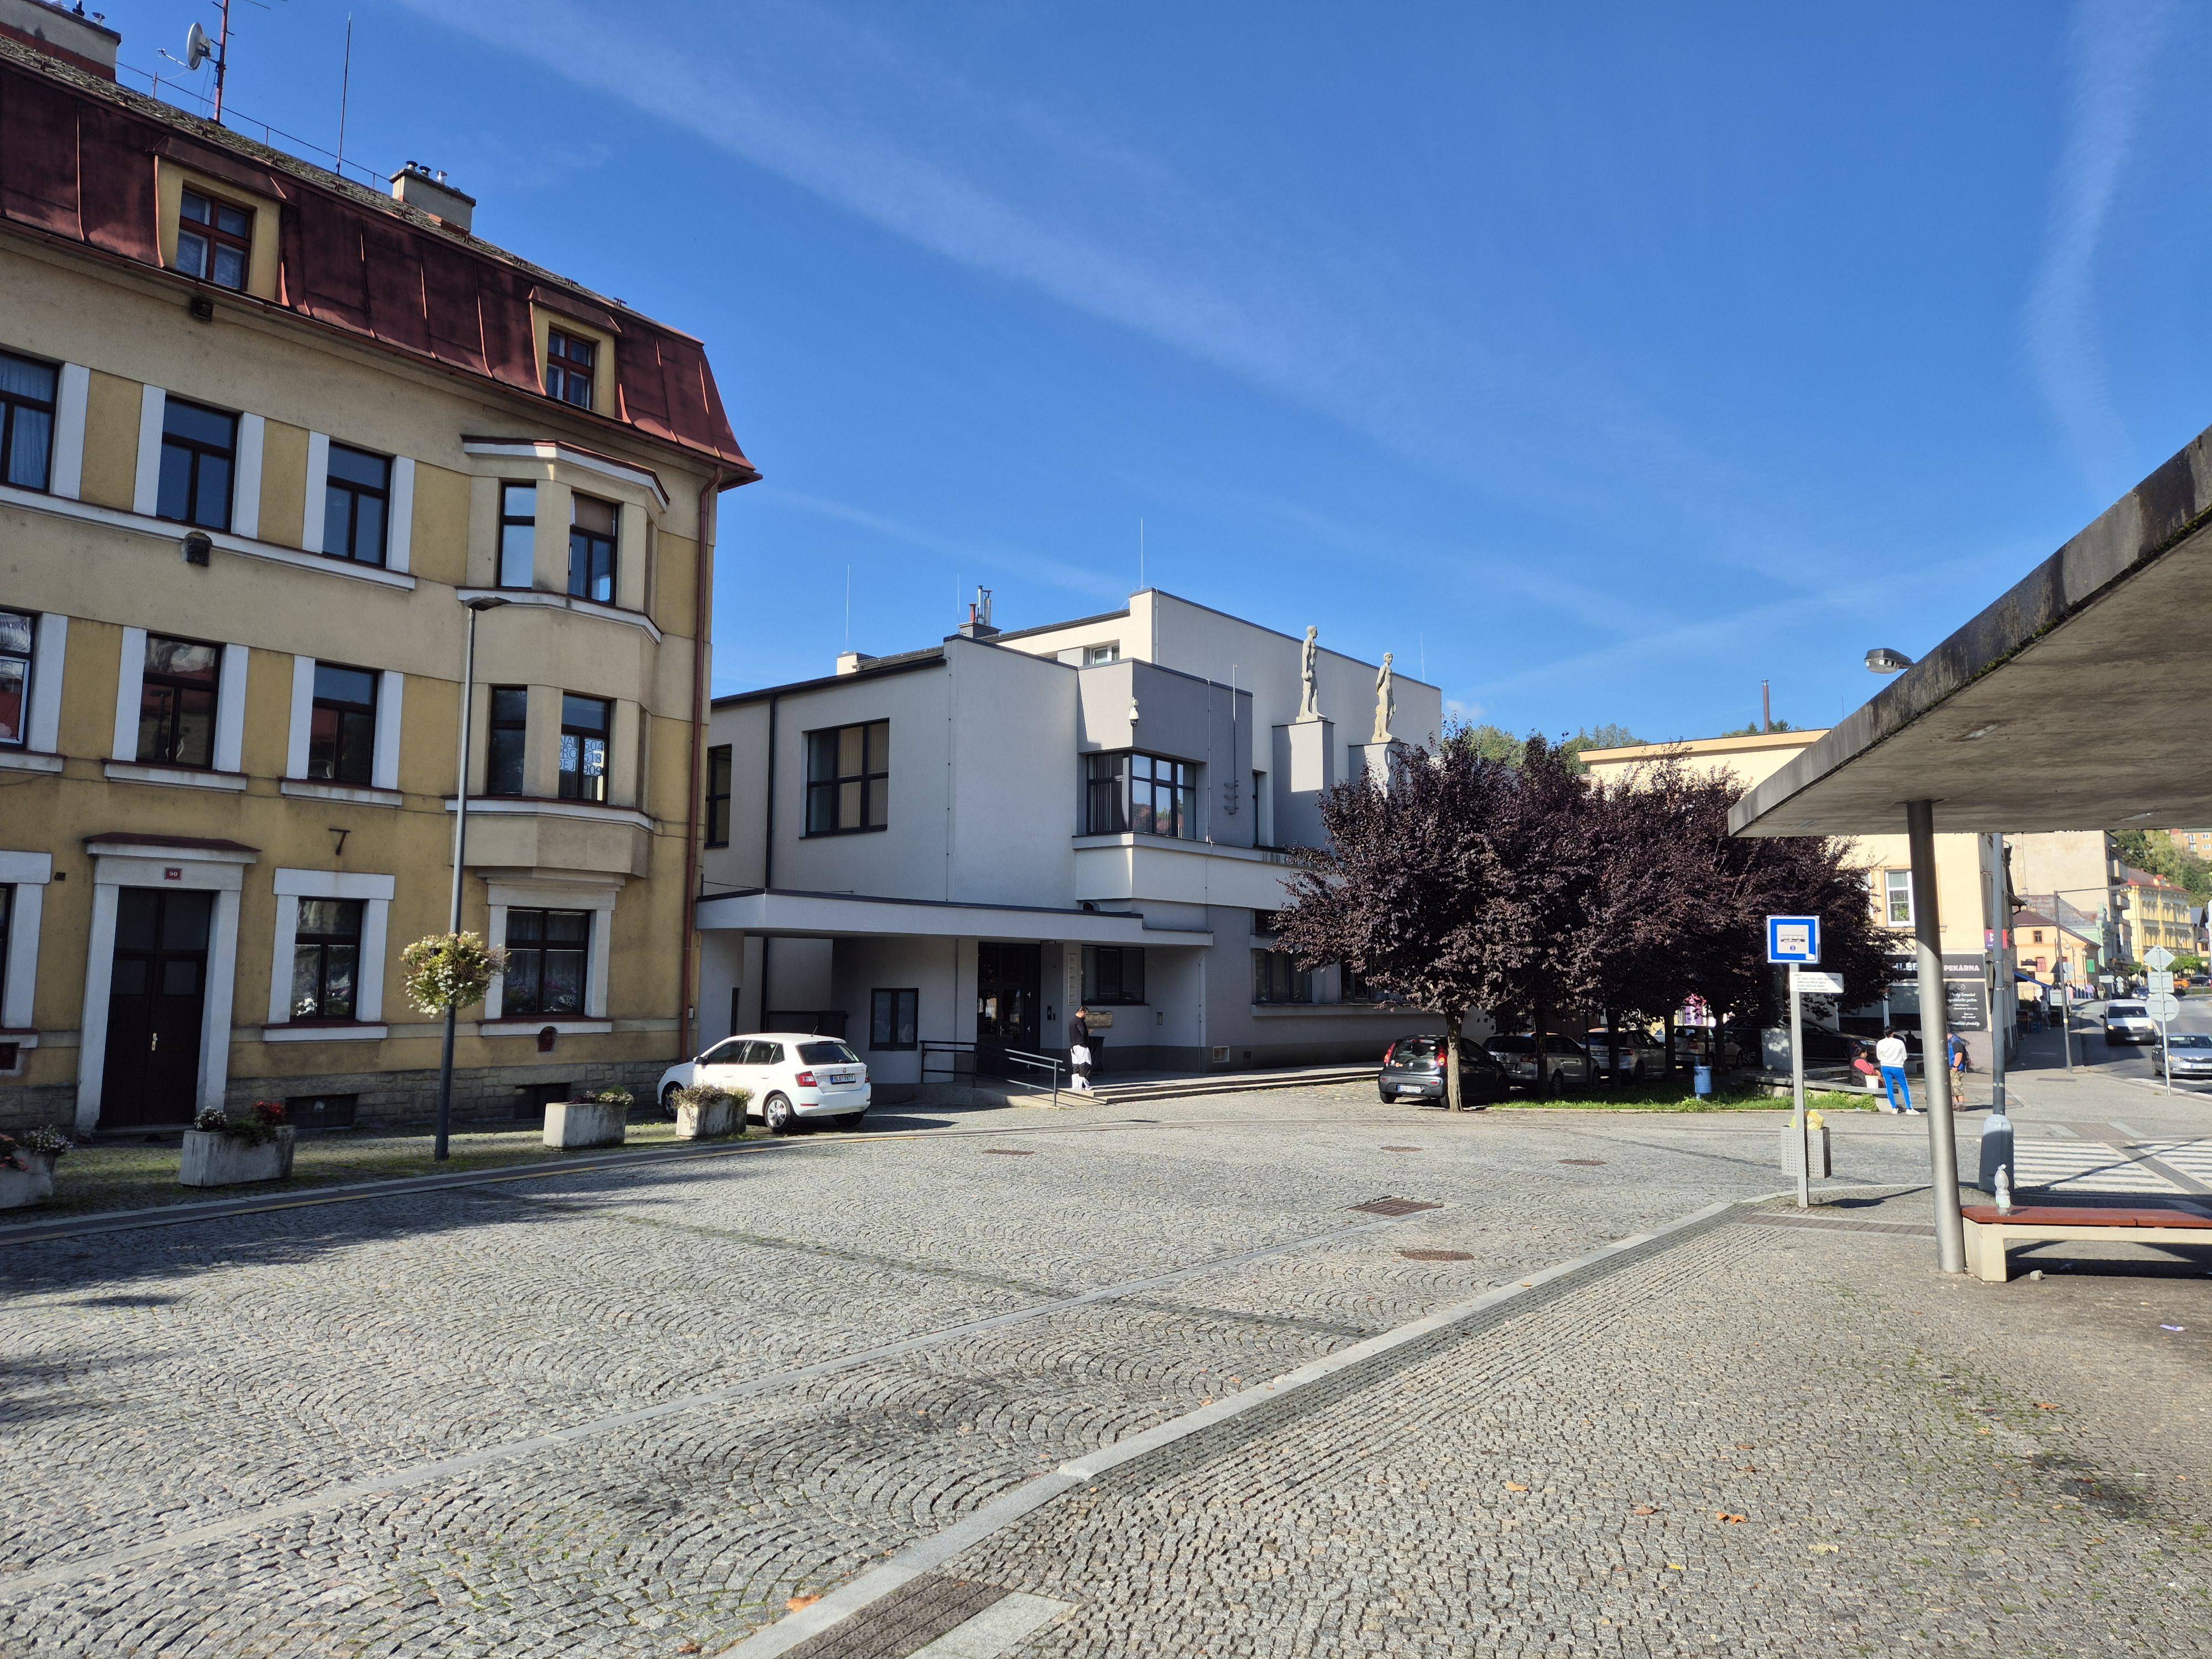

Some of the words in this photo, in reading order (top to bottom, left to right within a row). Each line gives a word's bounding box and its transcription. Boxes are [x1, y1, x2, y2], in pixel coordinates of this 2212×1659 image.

[585, 740, 603, 751] 604
[585, 752, 602, 763] 618
[584, 764, 602, 776] 909
